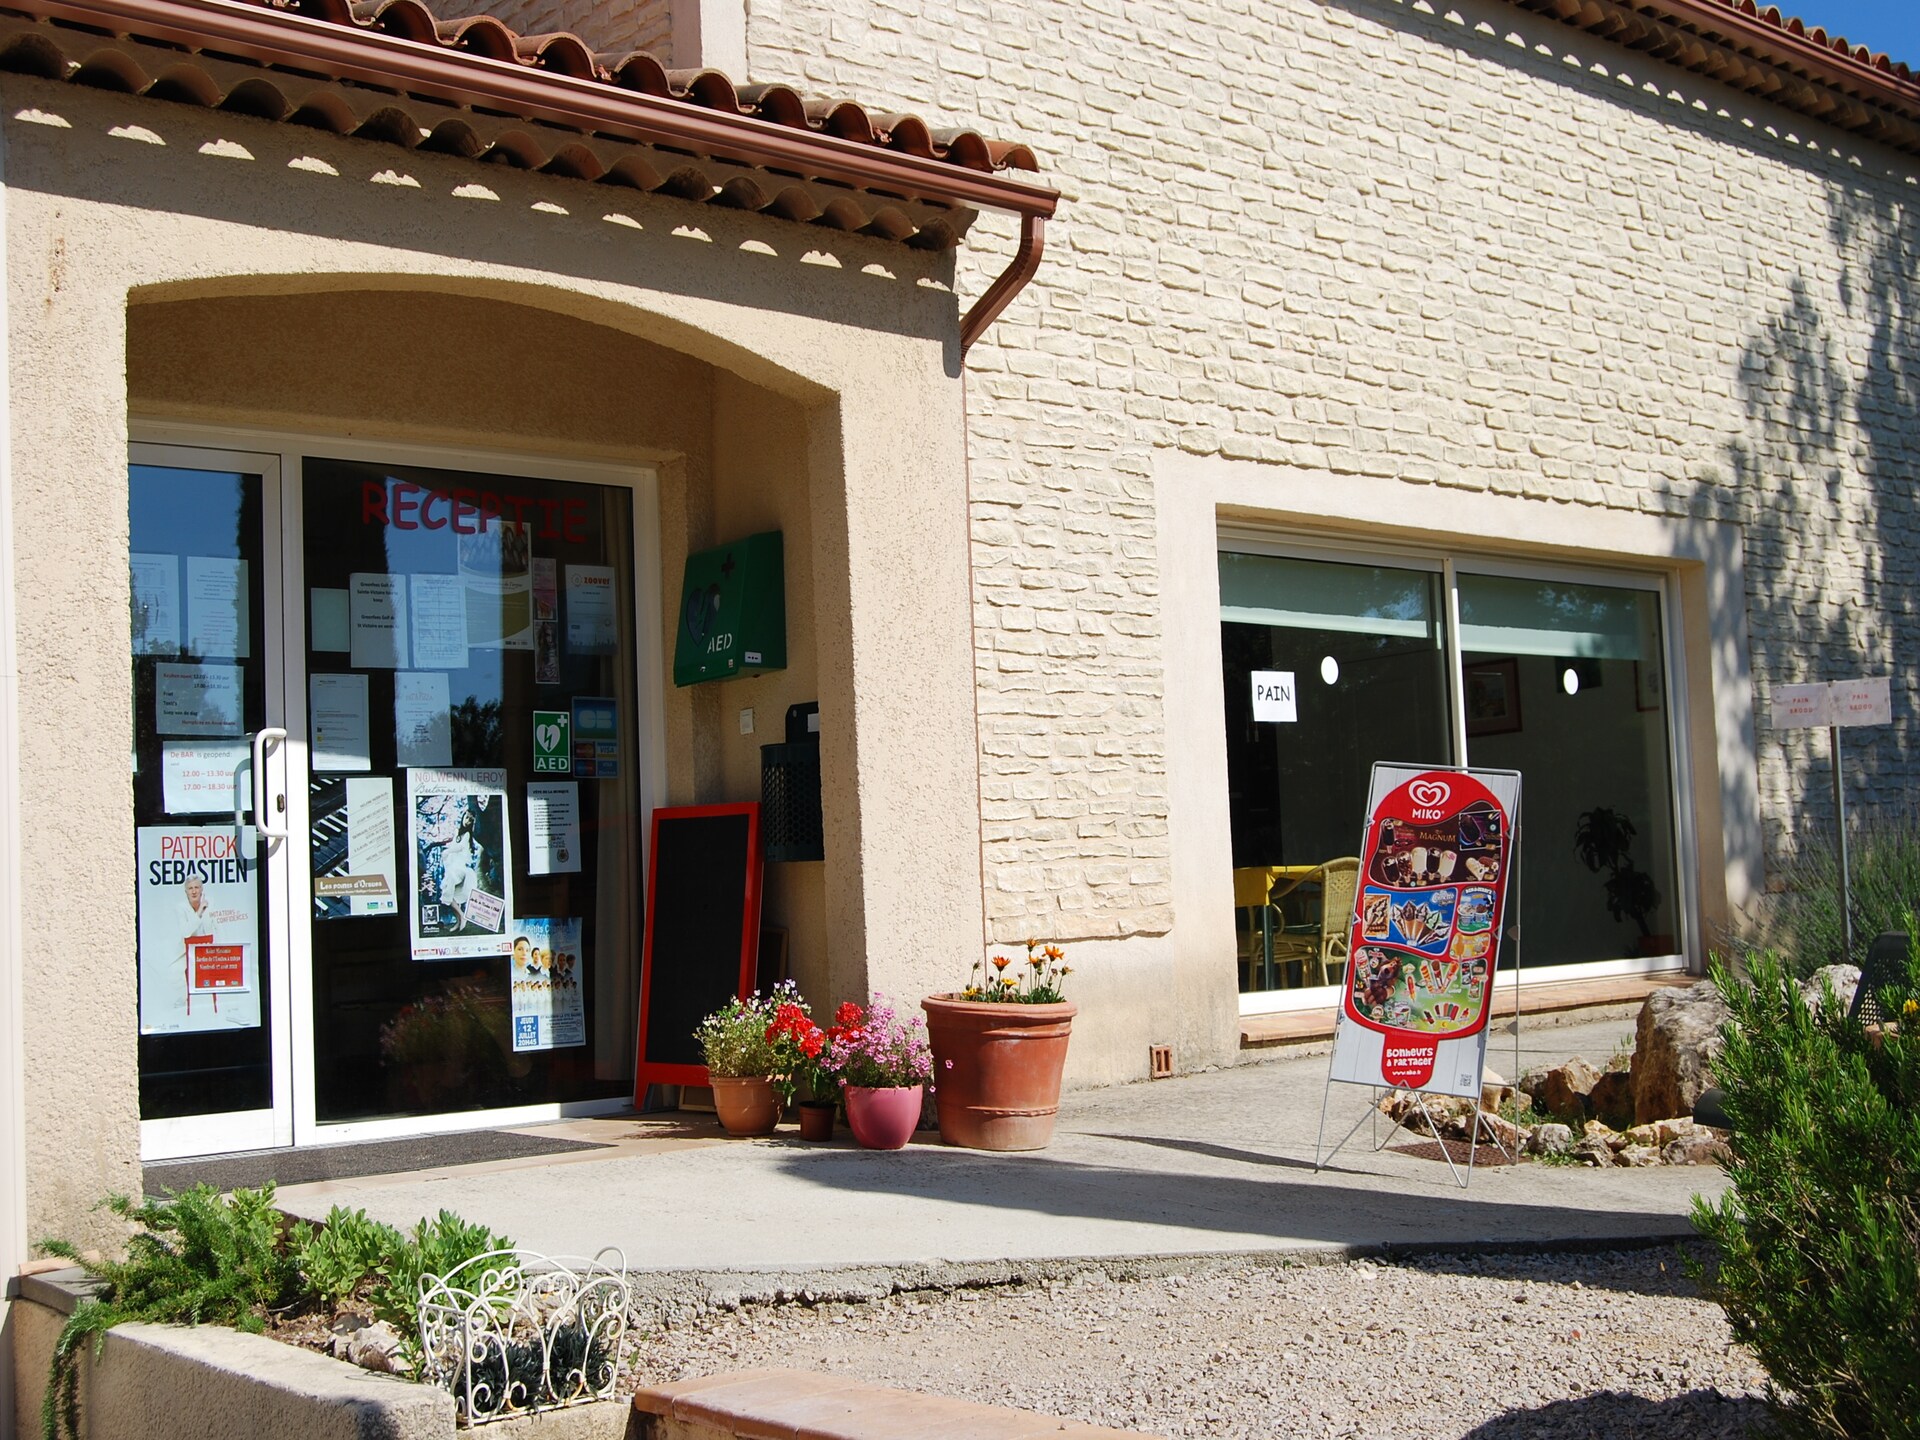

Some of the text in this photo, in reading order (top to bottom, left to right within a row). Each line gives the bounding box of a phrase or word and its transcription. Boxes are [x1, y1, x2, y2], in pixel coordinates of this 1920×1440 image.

[362, 481, 587, 543] RECEPTIE
[584, 576, 610, 585] zoover
[707, 633, 733, 654] AED
[1257, 684, 1290, 701] PAIN
[537, 758, 568, 770] AED
[471, 772, 504, 782] LEROY
[1412, 809, 1441, 819] MIKO
[1420, 831, 1456, 842] MAGNUM
[161, 836, 239, 859] PATRICK
[149, 859, 247, 885] SEBASTIEN
[320, 880, 332, 890] Les
[526, 924, 543, 933] Petits
[518, 1038, 537, 1046] 20H45
